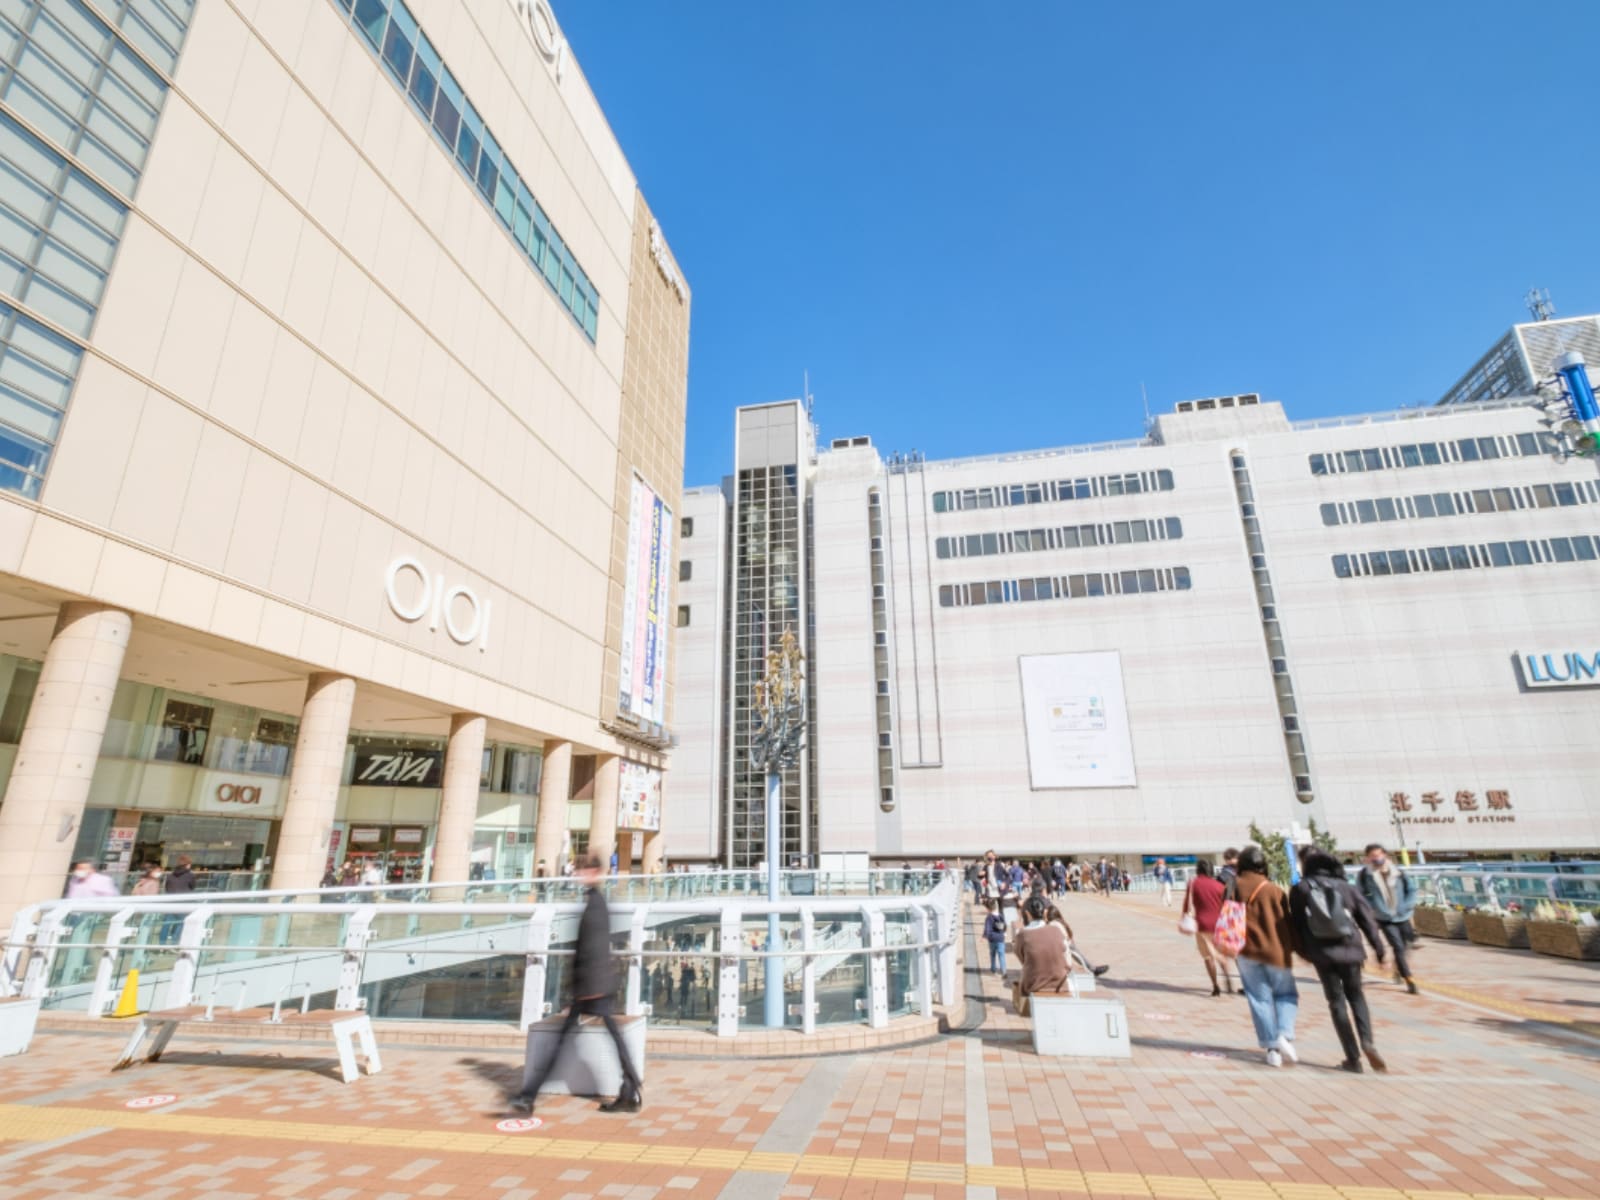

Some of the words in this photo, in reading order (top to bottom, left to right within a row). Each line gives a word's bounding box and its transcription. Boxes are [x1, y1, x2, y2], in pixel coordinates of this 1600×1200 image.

[1526, 651, 1600, 682] LUM
[358, 754, 434, 782] TAYA
[1390, 789, 1512, 811] 北千住駅
